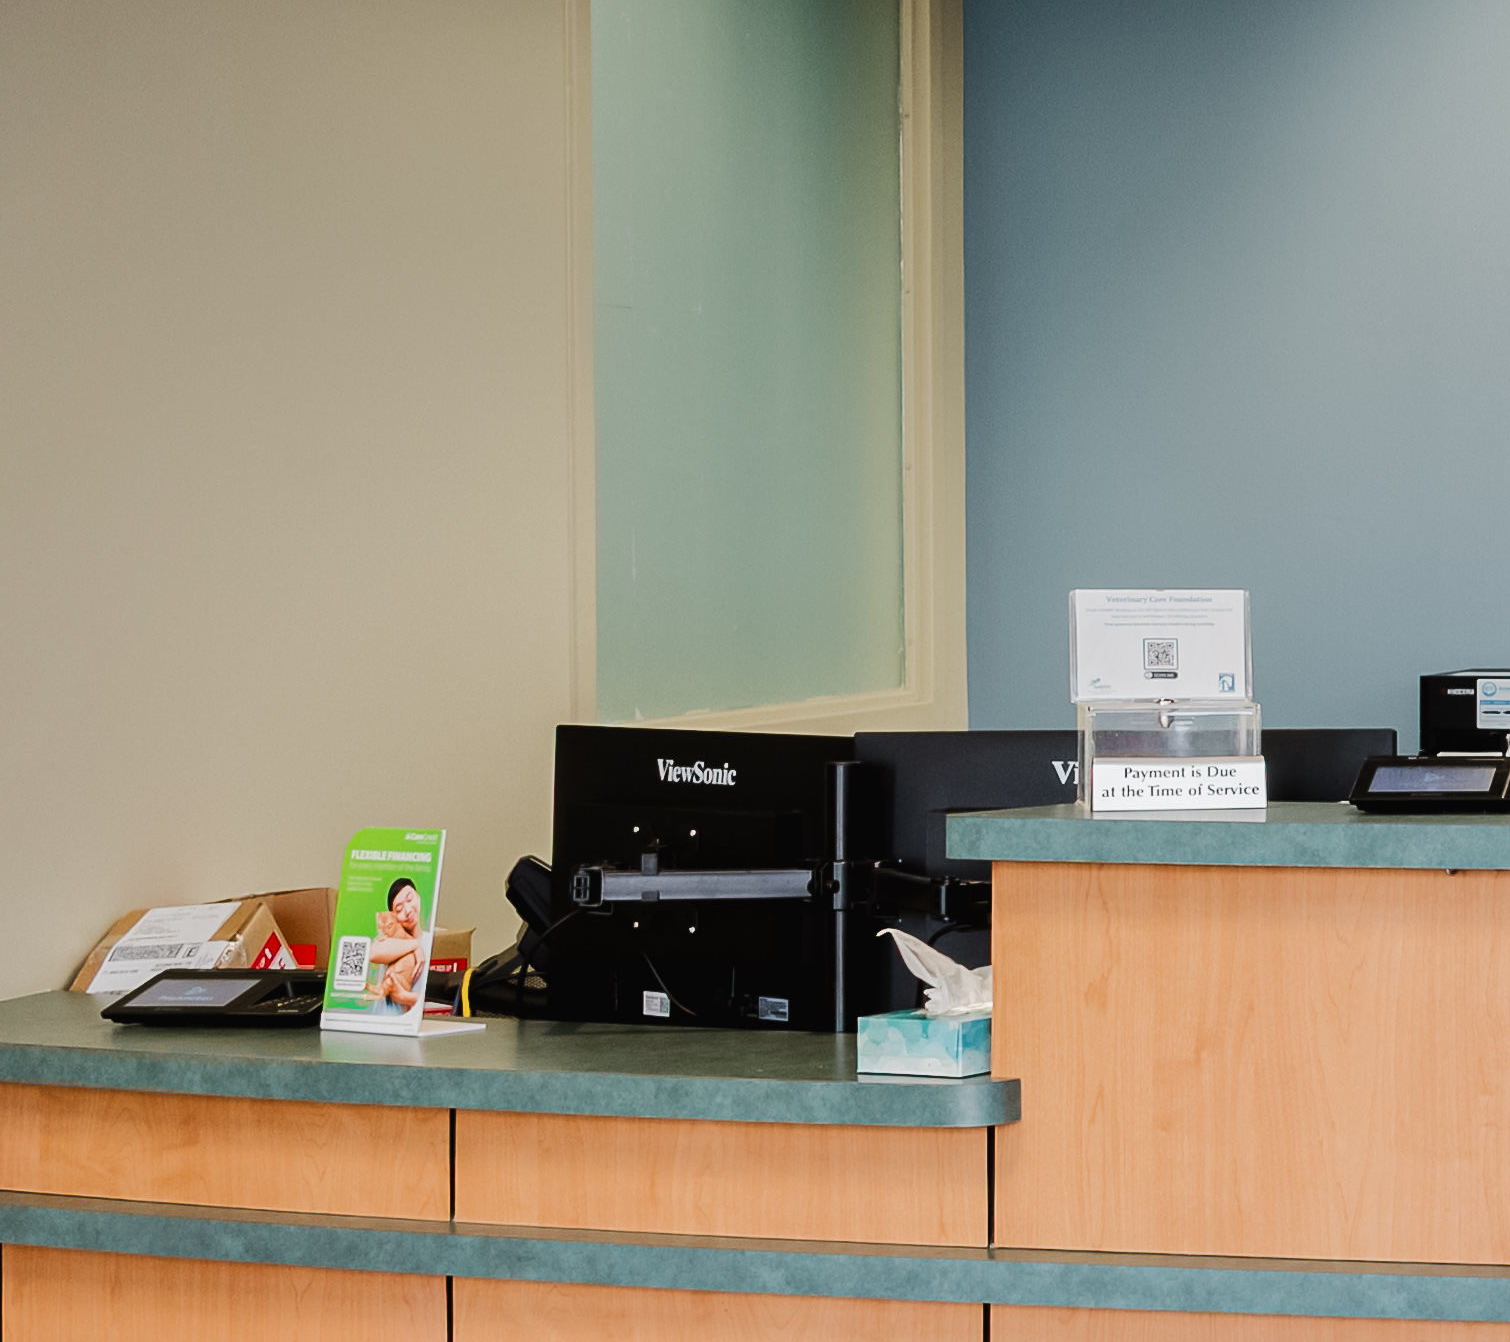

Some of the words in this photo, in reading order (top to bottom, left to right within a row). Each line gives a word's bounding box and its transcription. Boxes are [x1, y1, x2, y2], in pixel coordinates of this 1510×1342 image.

[657, 758, 737, 786] ViewSonic
[1124, 767, 1186, 783] Payment
[1191, 766, 1202, 778] is
[1207, 766, 1237, 778] Due
[1102, 787, 1115, 798] at
[1121, 786, 1144, 798] the
[1149, 785, 1183, 797] Time
[1188, 784, 1202, 796] of
[1207, 783, 1260, 796] Service
[351, 850, 387, 861] FLEXIBLE
[387, 851, 432, 863] FINANCING
